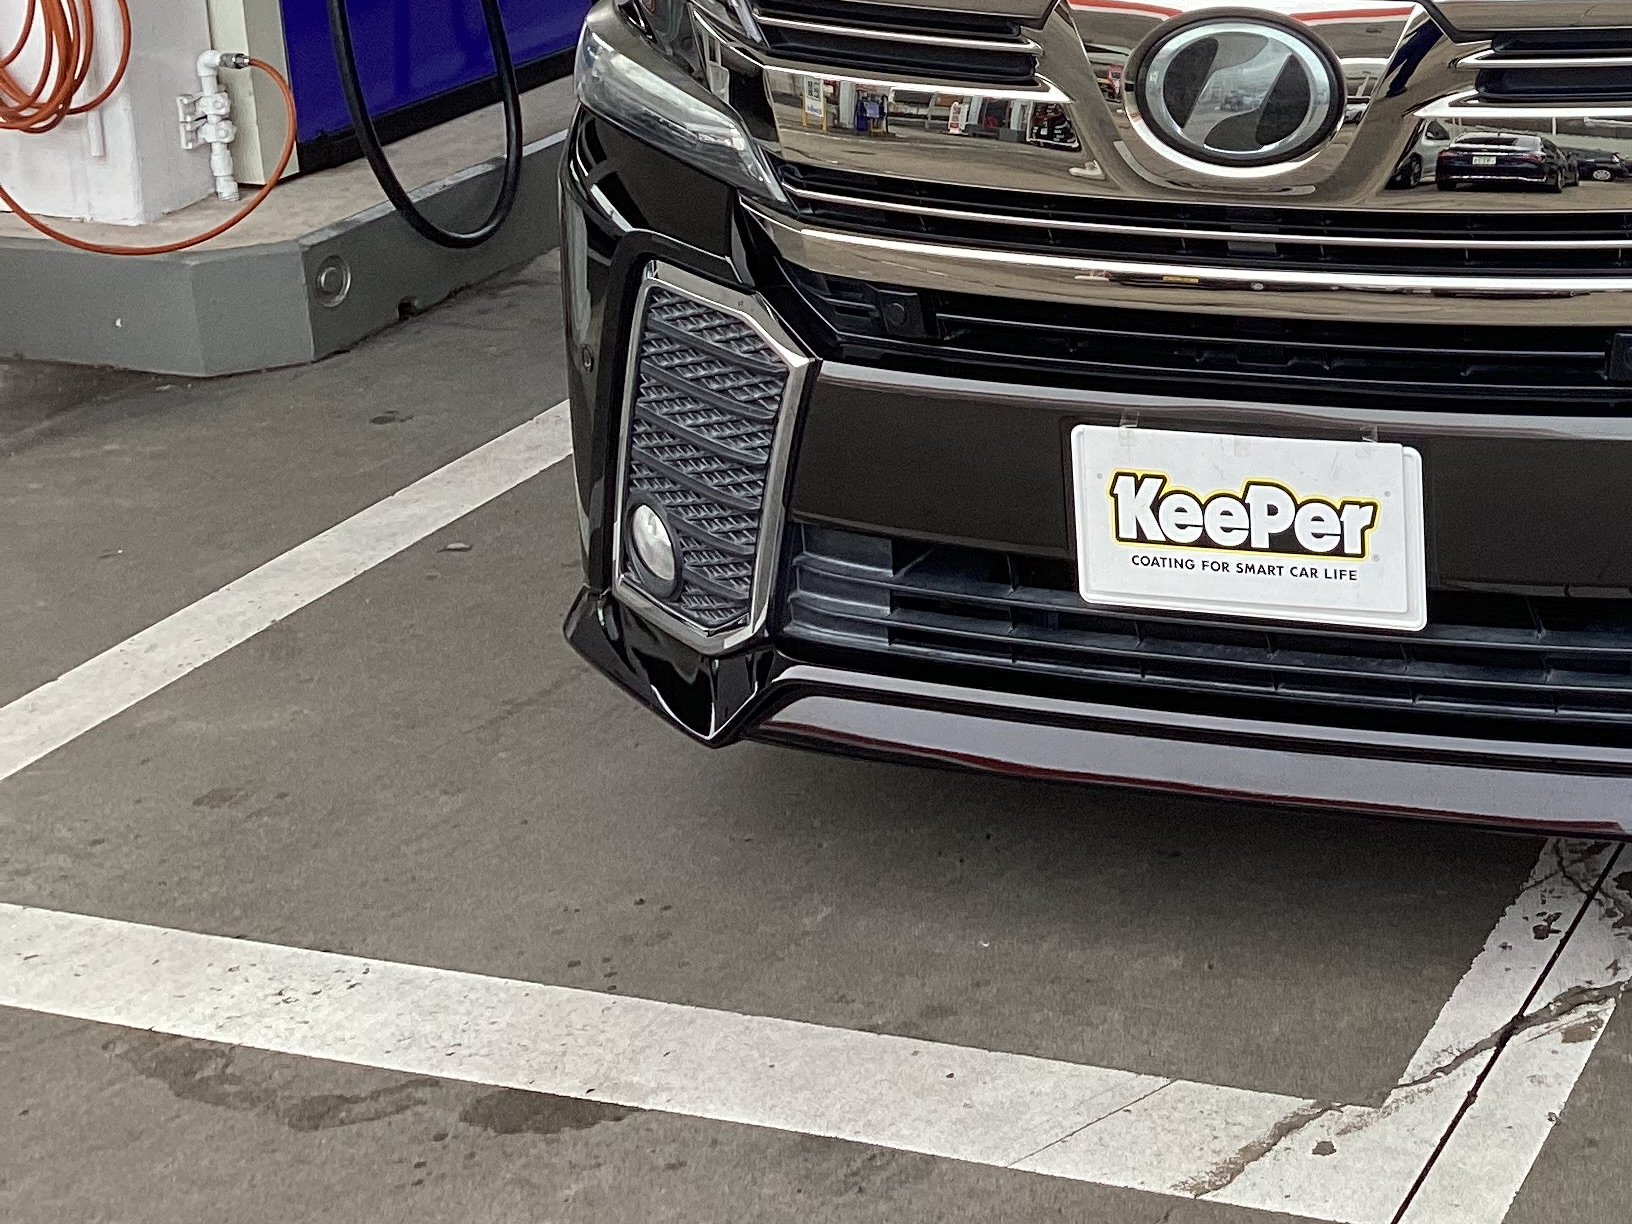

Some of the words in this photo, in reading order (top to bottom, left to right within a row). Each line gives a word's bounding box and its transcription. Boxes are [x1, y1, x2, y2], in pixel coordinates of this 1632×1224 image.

[1110, 471, 1378, 558] KeePer
[1131, 554, 1195, 571] COATING
[1201, 560, 1230, 573] FOR
[1235, 562, 1284, 577] SMART
[1289, 566, 1319, 579] CAR
[1324, 568, 1358, 581] LIFE
